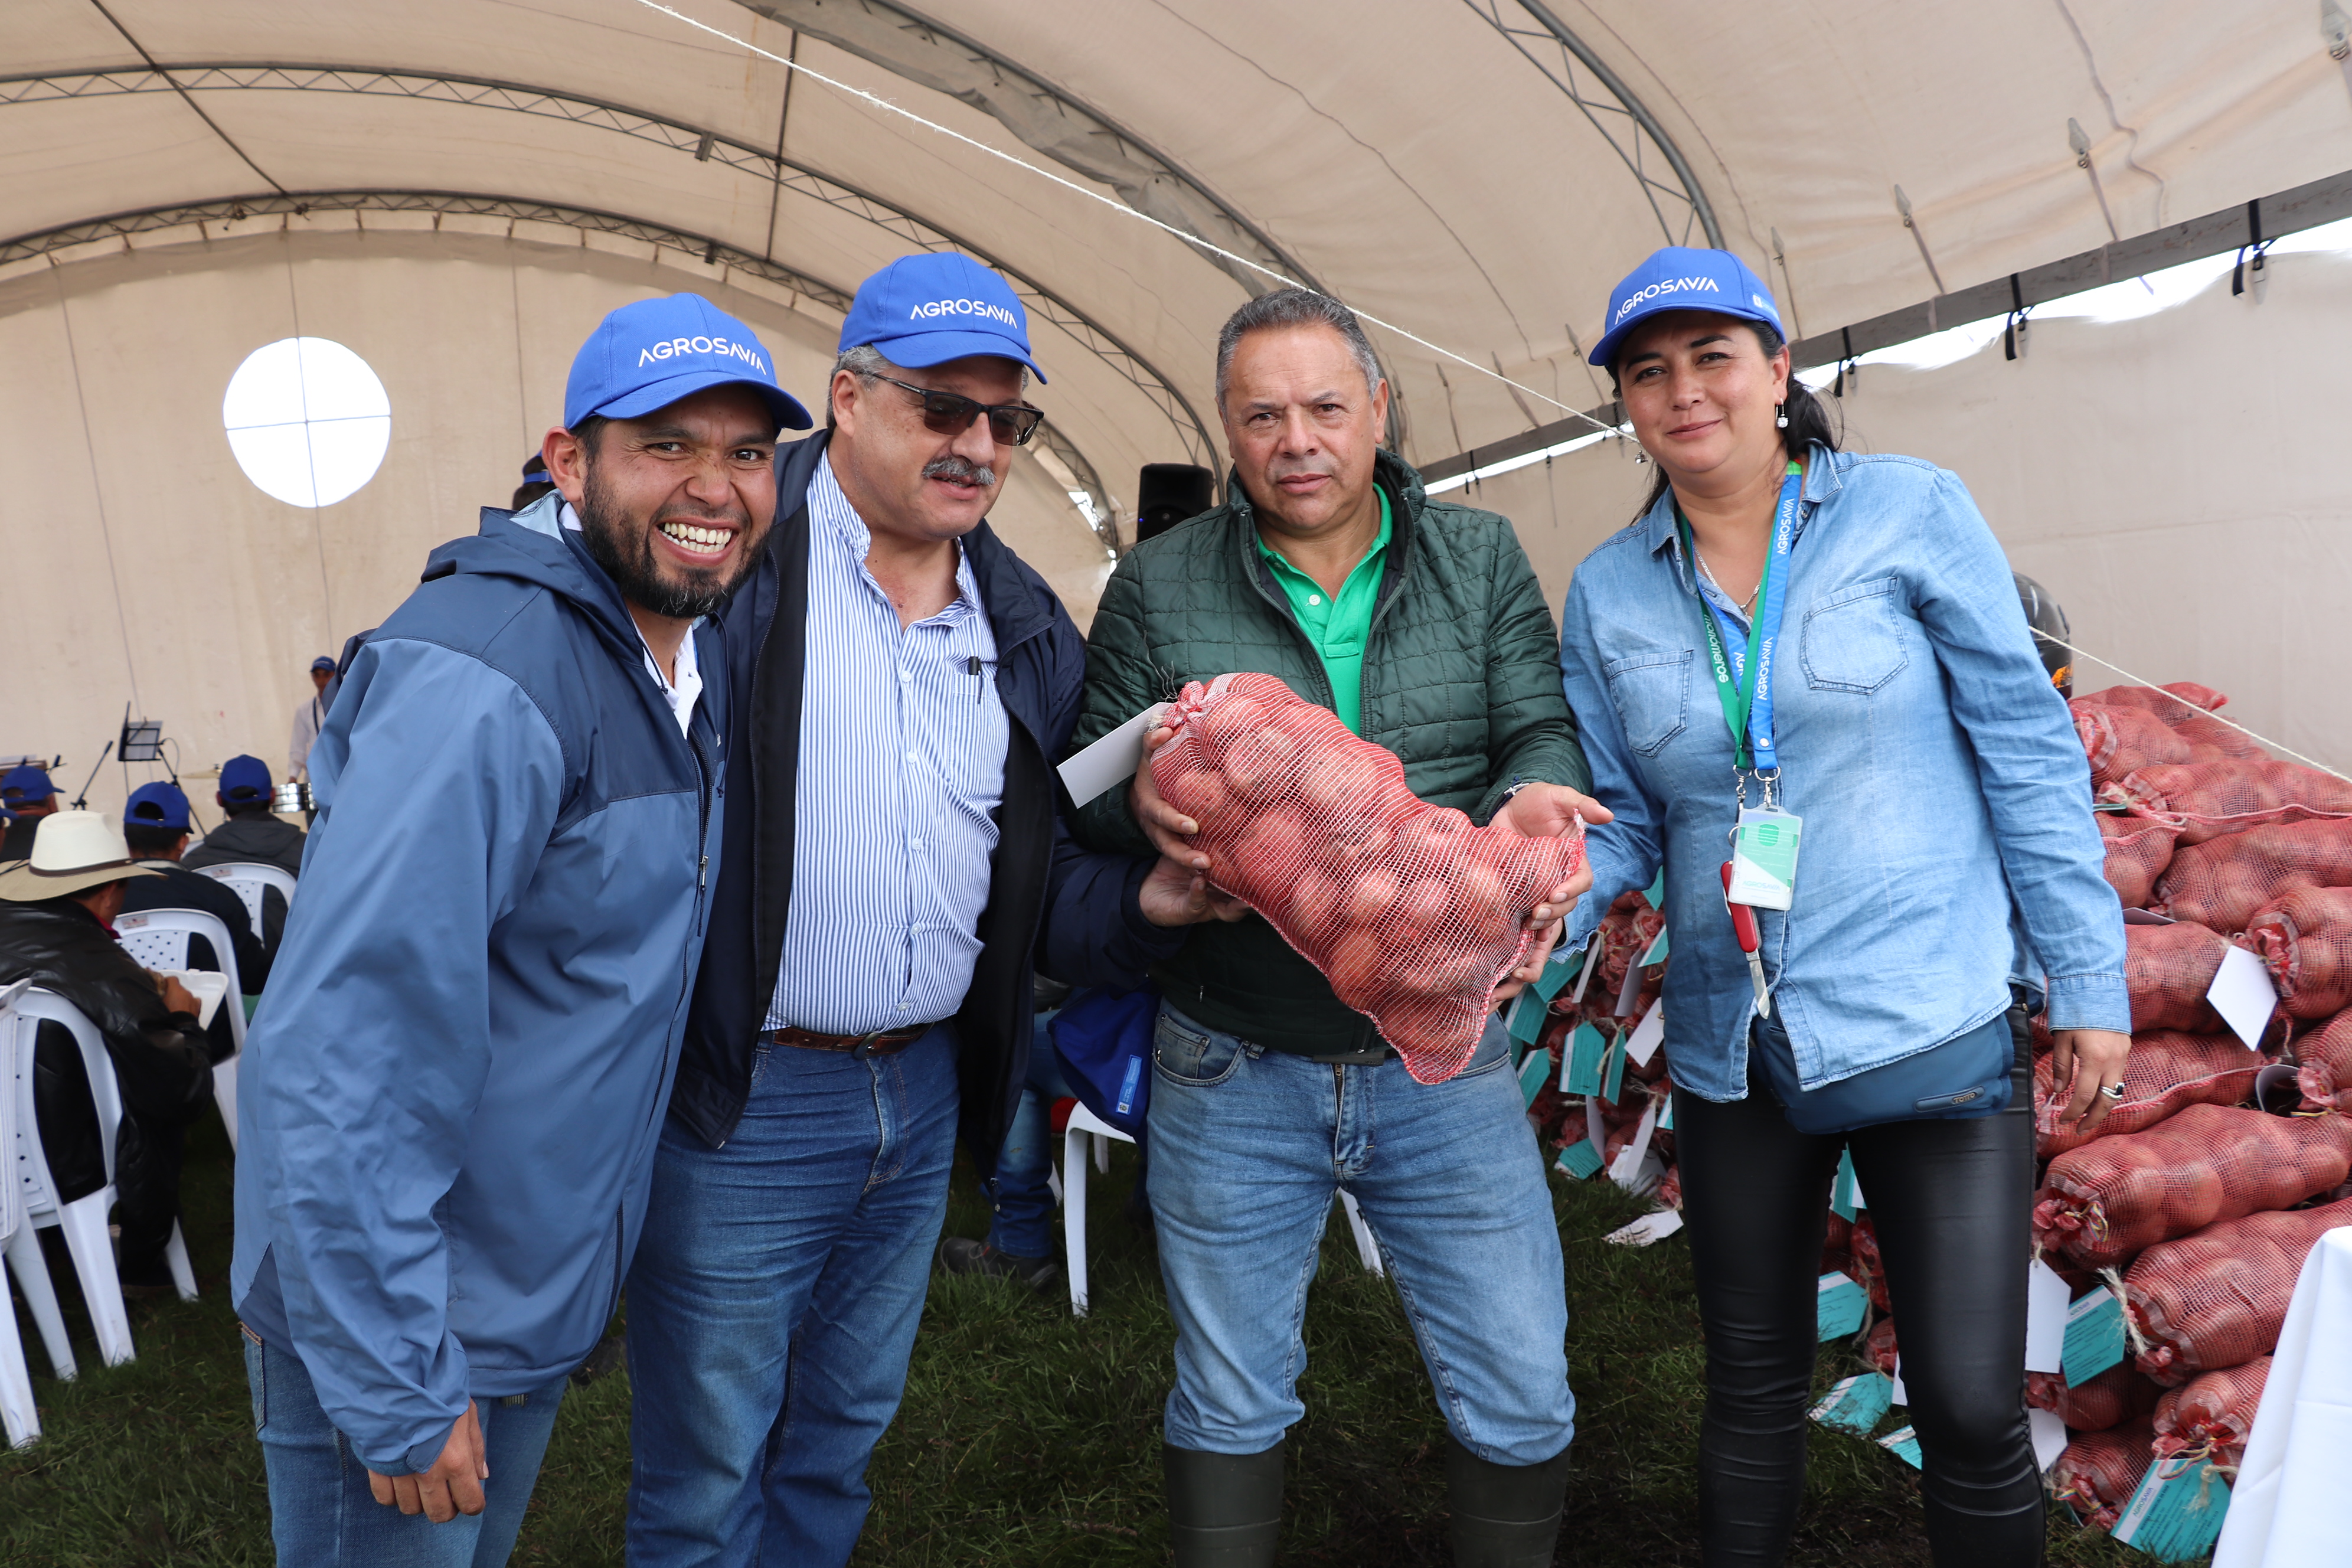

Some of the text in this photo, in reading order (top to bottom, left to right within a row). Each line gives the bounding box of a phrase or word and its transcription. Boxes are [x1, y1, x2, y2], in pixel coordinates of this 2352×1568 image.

[910, 298, 1017, 329] AGROSAVIA
[1615, 276, 1719, 325] AGROSAVIA
[638, 336, 766, 375] AGROSAVIA
[1777, 498, 1795, 555] AGROSAVIA
[1704, 614, 1729, 683] monómeros
[1757, 636, 1773, 701] AGROSAVIA
[1742, 881, 1781, 891] AGROSAVIA
[1953, 1092, 1976, 1103] TOTTO
[2133, 1488, 2153, 1516] AGROSAVIA
